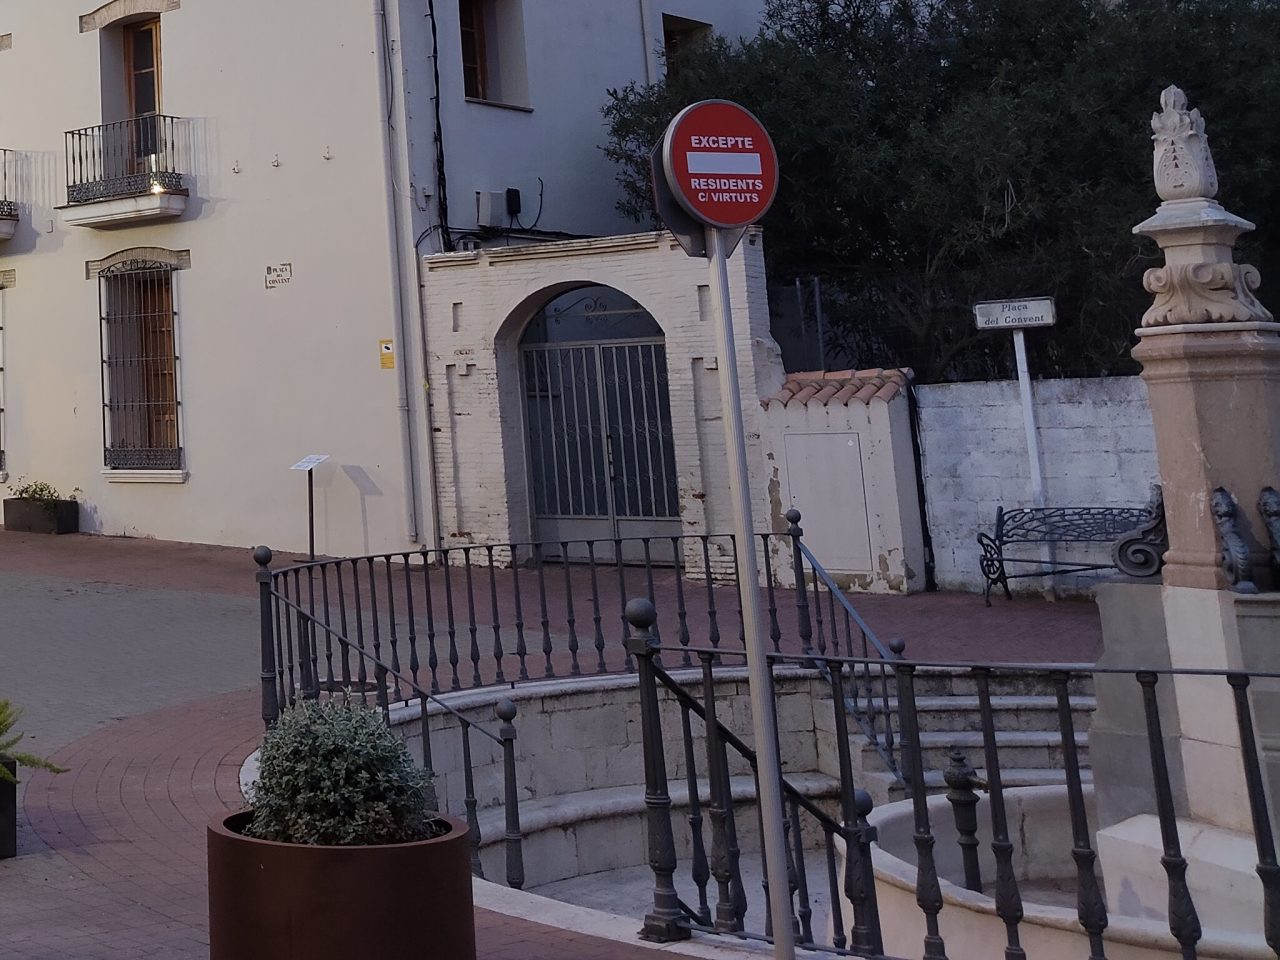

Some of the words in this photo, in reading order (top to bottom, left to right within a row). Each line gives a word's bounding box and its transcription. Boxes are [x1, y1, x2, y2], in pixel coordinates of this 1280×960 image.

[690, 135, 754, 149] EXCEPTE
[690, 178, 763, 191] RESIDENTS
[698, 192, 709, 202] C/
[711, 192, 759, 203] VIRTUTS
[984, 317, 999, 325] del
[1004, 314, 1044, 324] Convent
